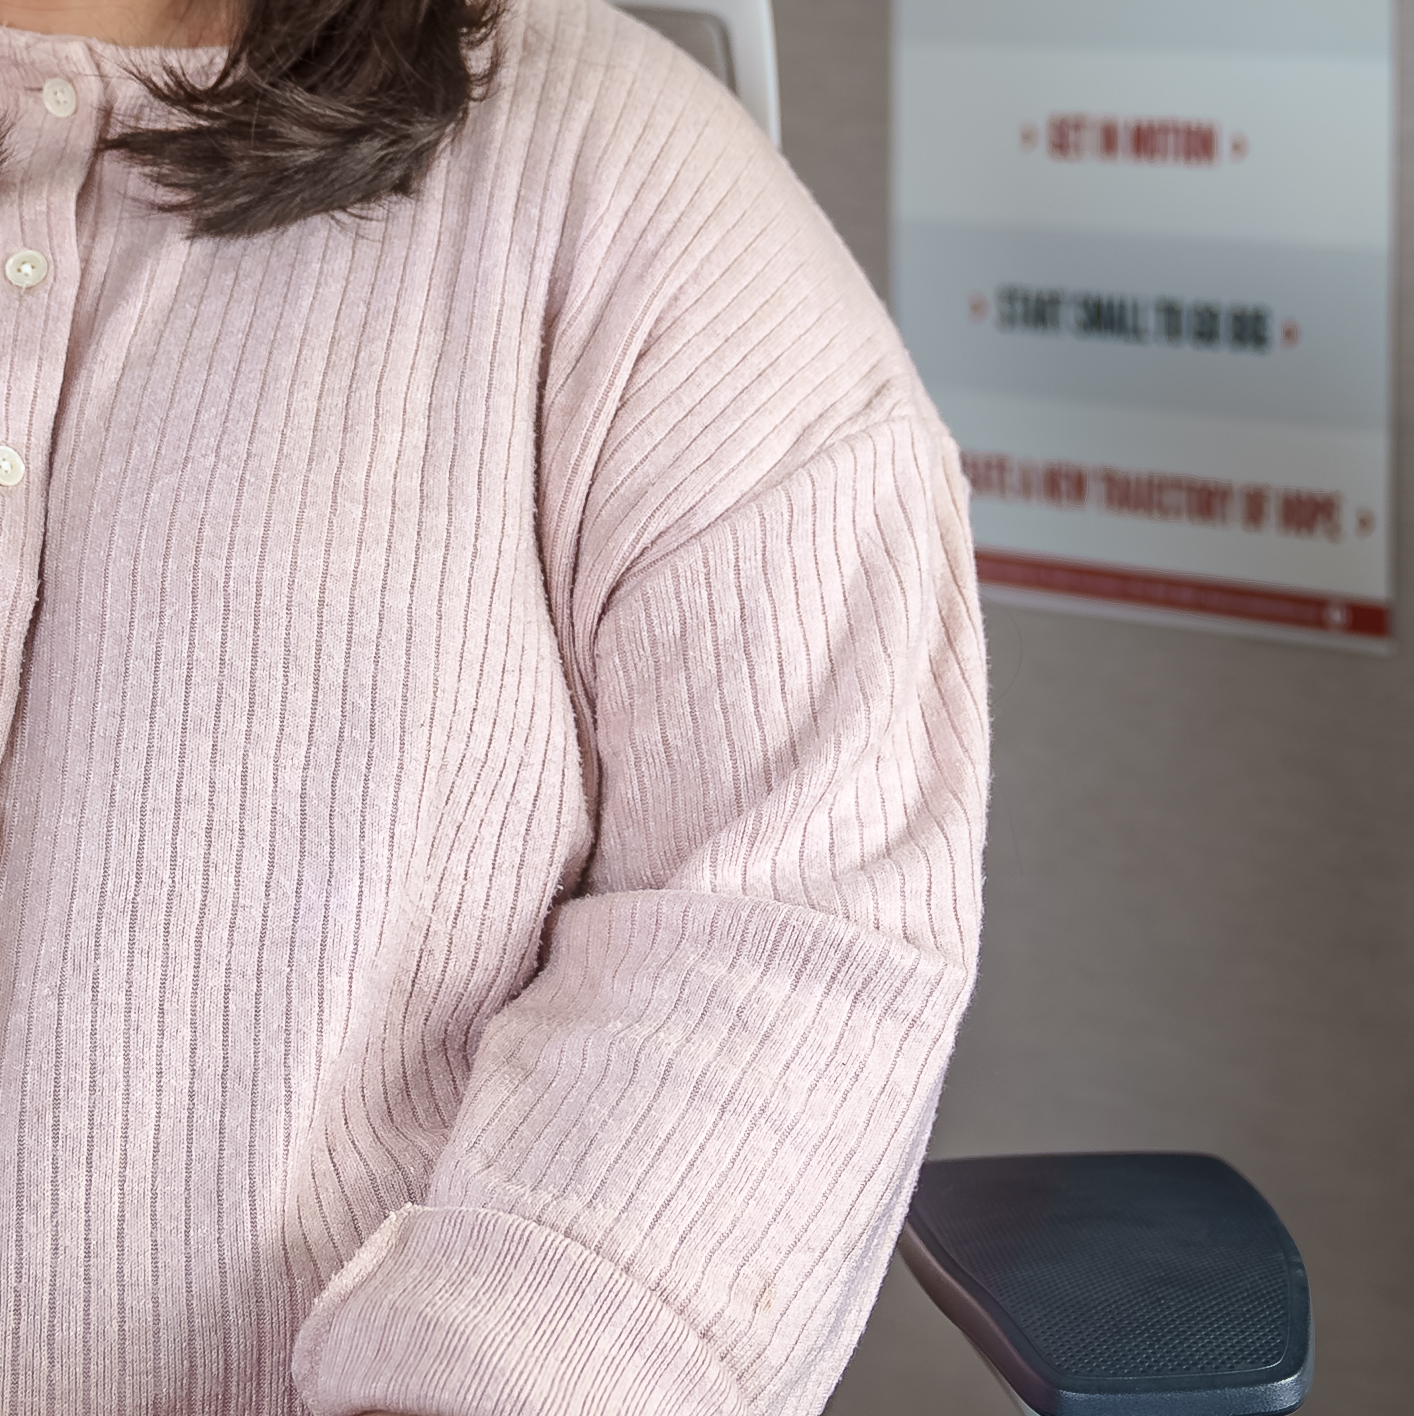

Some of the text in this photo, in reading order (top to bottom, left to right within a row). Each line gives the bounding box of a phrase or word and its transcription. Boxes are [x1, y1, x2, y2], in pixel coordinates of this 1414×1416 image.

[1130, 118, 1218, 166] MOTION
[996, 286, 1063, 337] START
[1074, 290, 1146, 343] SMALL
[1155, 295, 1182, 346] TO
[1043, 460, 1088, 509] NEW
[1102, 466, 1232, 527] TRAJECTORY
[1242, 483, 1270, 533] OF
[1278, 488, 1344, 543] HOPE
